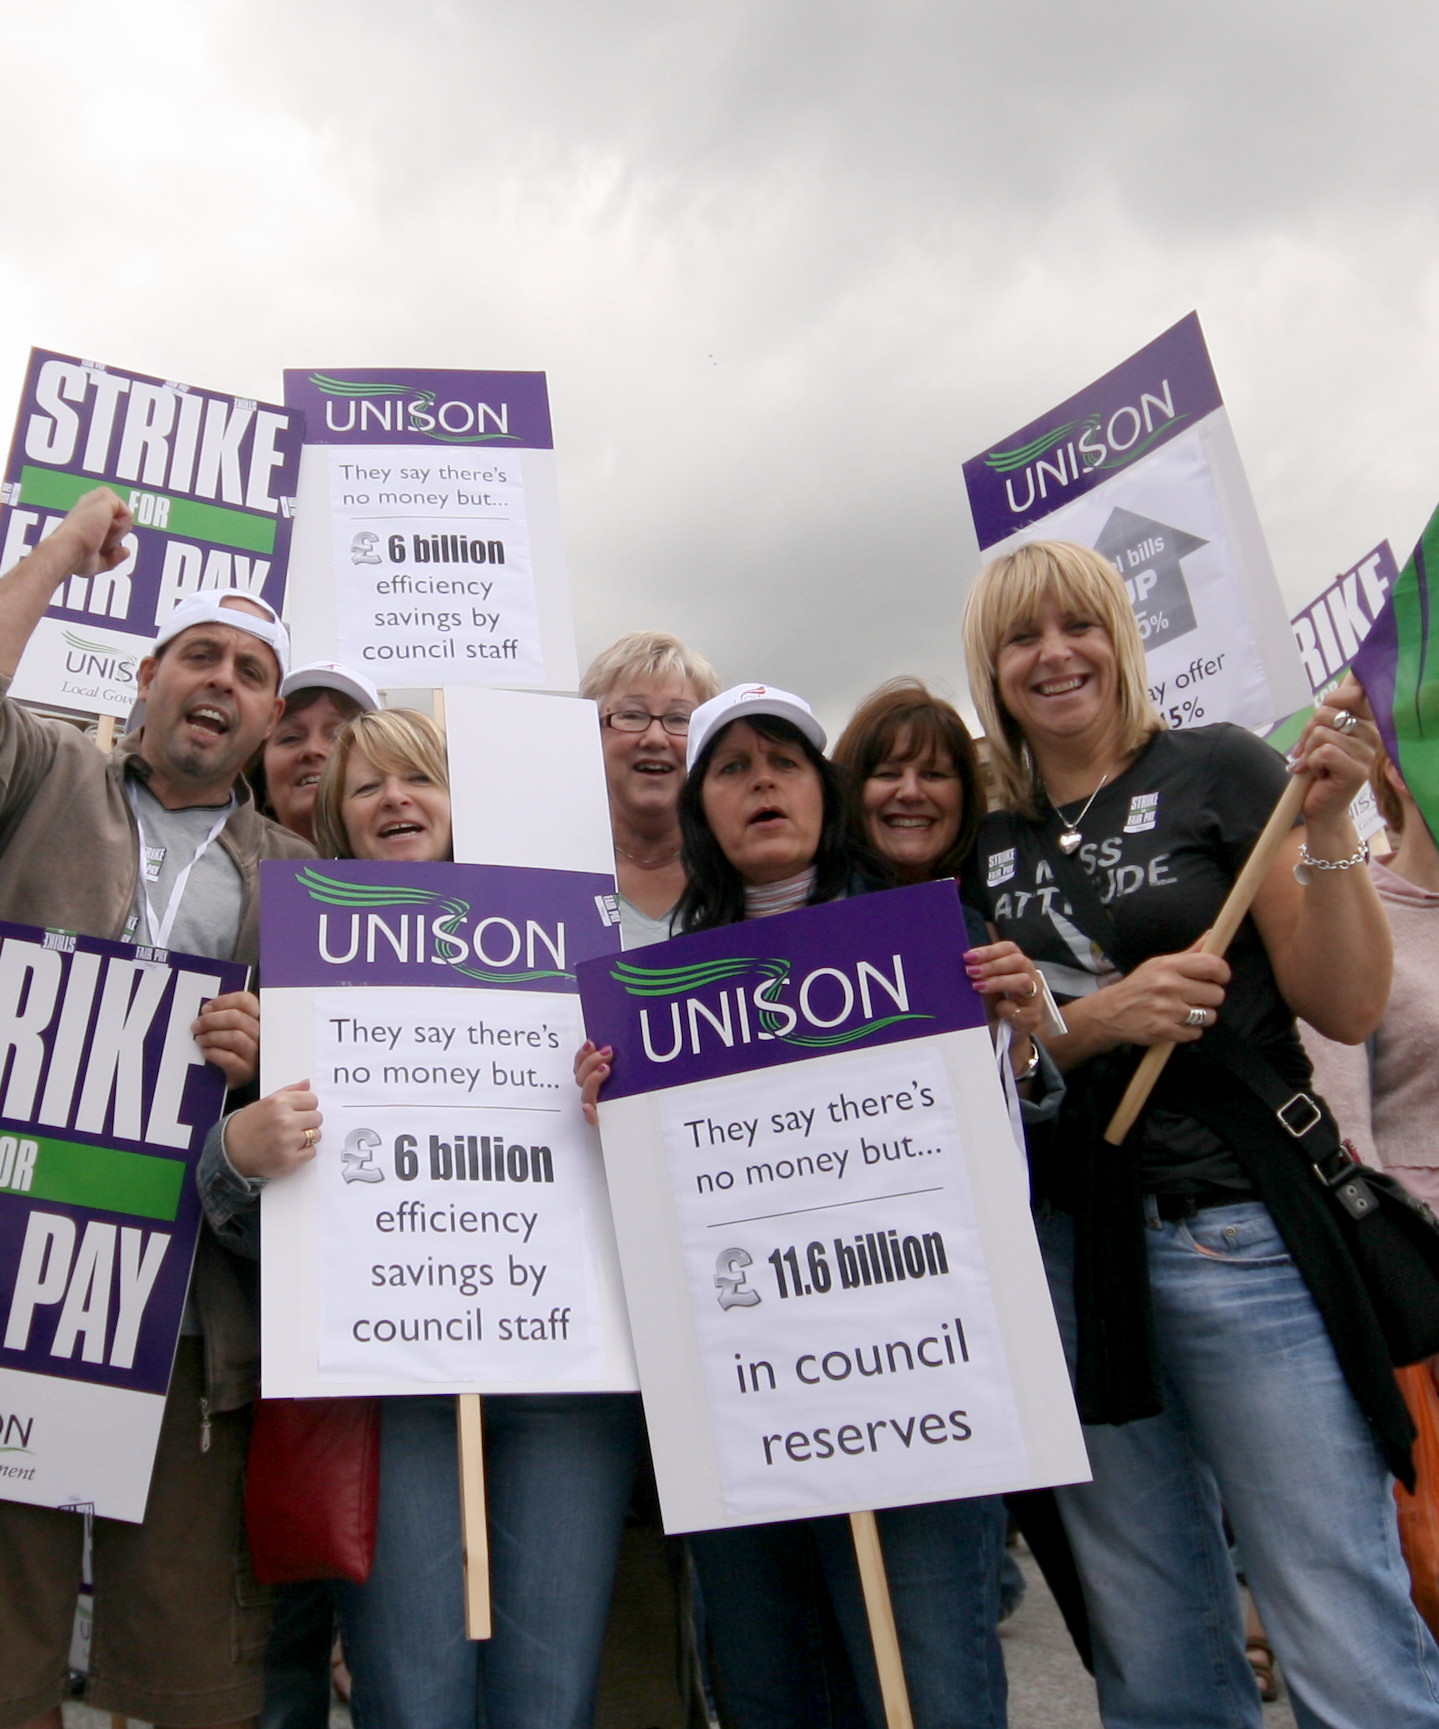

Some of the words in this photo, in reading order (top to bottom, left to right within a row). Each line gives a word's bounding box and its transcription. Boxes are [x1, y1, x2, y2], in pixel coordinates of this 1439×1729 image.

[327, 399, 509, 436] UNISON
[25, 360, 289, 513] STRIKE
[1006, 379, 1175, 513] UNISON
[339, 464, 391, 485] They
[400, 469, 429, 487] say
[439, 465, 508, 485] there's
[128, 490, 171, 529] FOR
[342, 492, 370, 505] no
[378, 492, 448, 510] money
[413, 534, 505, 564] billion
[1128, 535, 1166, 568] bills
[376, 575, 494, 600] efficiency
[374, 608, 462, 635] savings
[471, 608, 501, 635] by
[66, 651, 139, 684] UNIS
[362, 639, 459, 662] council
[466, 638, 518, 661] staff
[1176, 653, 1226, 691] offer
[1126, 812, 1144, 826] FAIR
[1143, 809, 1158, 824] PAY
[1130, 791, 1159, 811] STRIKE
[988, 847, 1016, 869] STRIKE
[988, 868, 1004, 881] FAIR
[43, 932, 77, 953] STRIKE
[318, 913, 566, 970] UNISON
[639, 954, 912, 1064] UNISON
[330, 1018, 403, 1050] They
[414, 1027, 457, 1053] say
[467, 1022, 560, 1049] there's
[334, 1064, 371, 1085] no
[383, 1065, 482, 1093] money
[492, 1061, 560, 1090] but...
[685, 1114, 760, 1151] They
[771, 1107, 817, 1136] say
[826, 1079, 936, 1124] there's
[429, 1134, 555, 1184] billion
[696, 1166, 736, 1195] no
[746, 1147, 850, 1187] money
[861, 1136, 942, 1164] but...
[375, 1201, 539, 1243] efficiency
[371, 1255, 494, 1296] savings
[508, 1254, 548, 1297] by
[768, 1240, 831, 1301] 11.6
[839, 1229, 950, 1291] billion
[3, 1211, 172, 1370] PAY
[352, 1308, 483, 1343] council
[498, 1306, 572, 1341] staff
[735, 1353, 777, 1394] in
[795, 1318, 971, 1385] council
[761, 1408, 973, 1466] reserves
